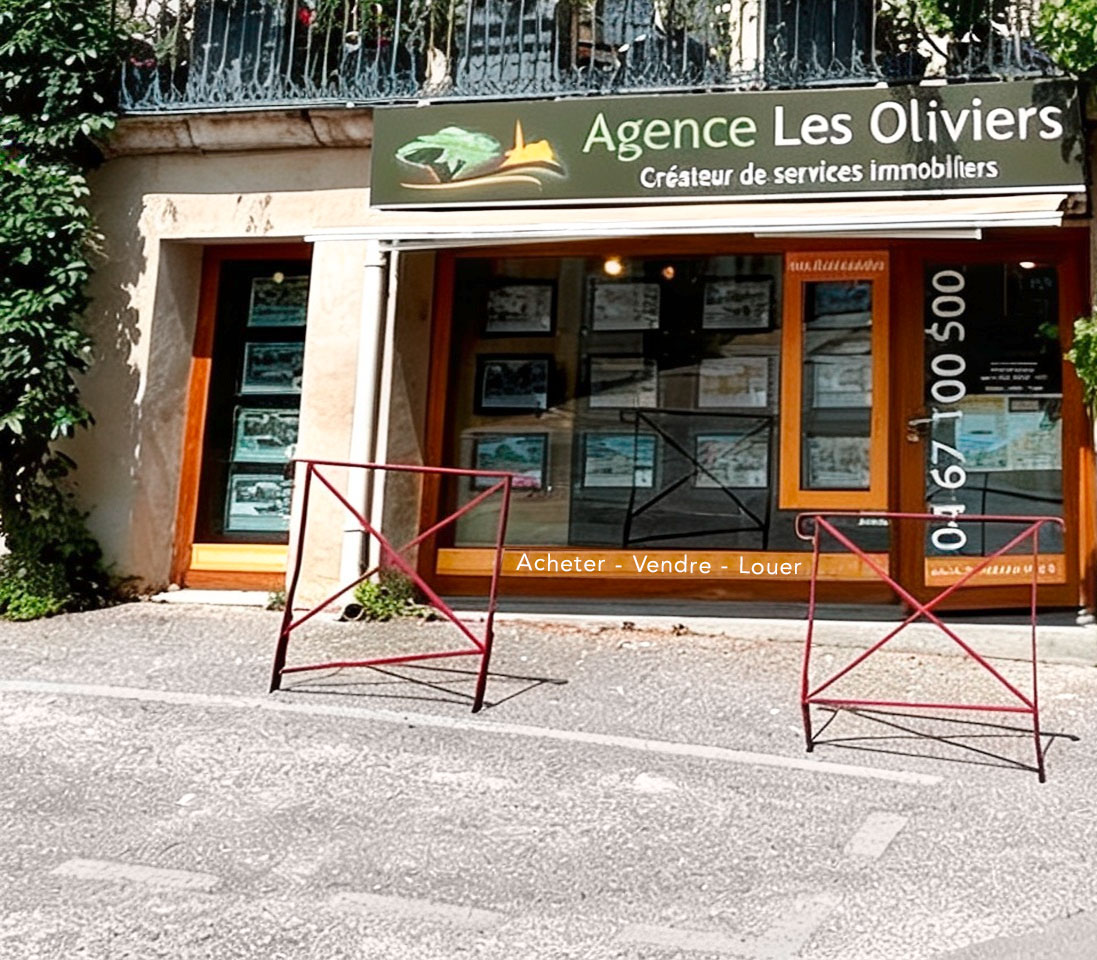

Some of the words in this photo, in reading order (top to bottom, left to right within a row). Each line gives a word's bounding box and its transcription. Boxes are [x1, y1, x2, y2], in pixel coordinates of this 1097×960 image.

[582, 112, 758, 162] Agence
[773, 105, 853, 146] Les
[869, 97, 1064, 145] Oliviers
[640, 164, 734, 189] Créateur
[739, 161, 768, 186] de
[772, 159, 864, 184] services
[930, 440, 967, 490] 67
[516, 553, 605, 572] Acheter
[633, 554, 711, 574] Vendre
[739, 556, 802, 575] Louer
